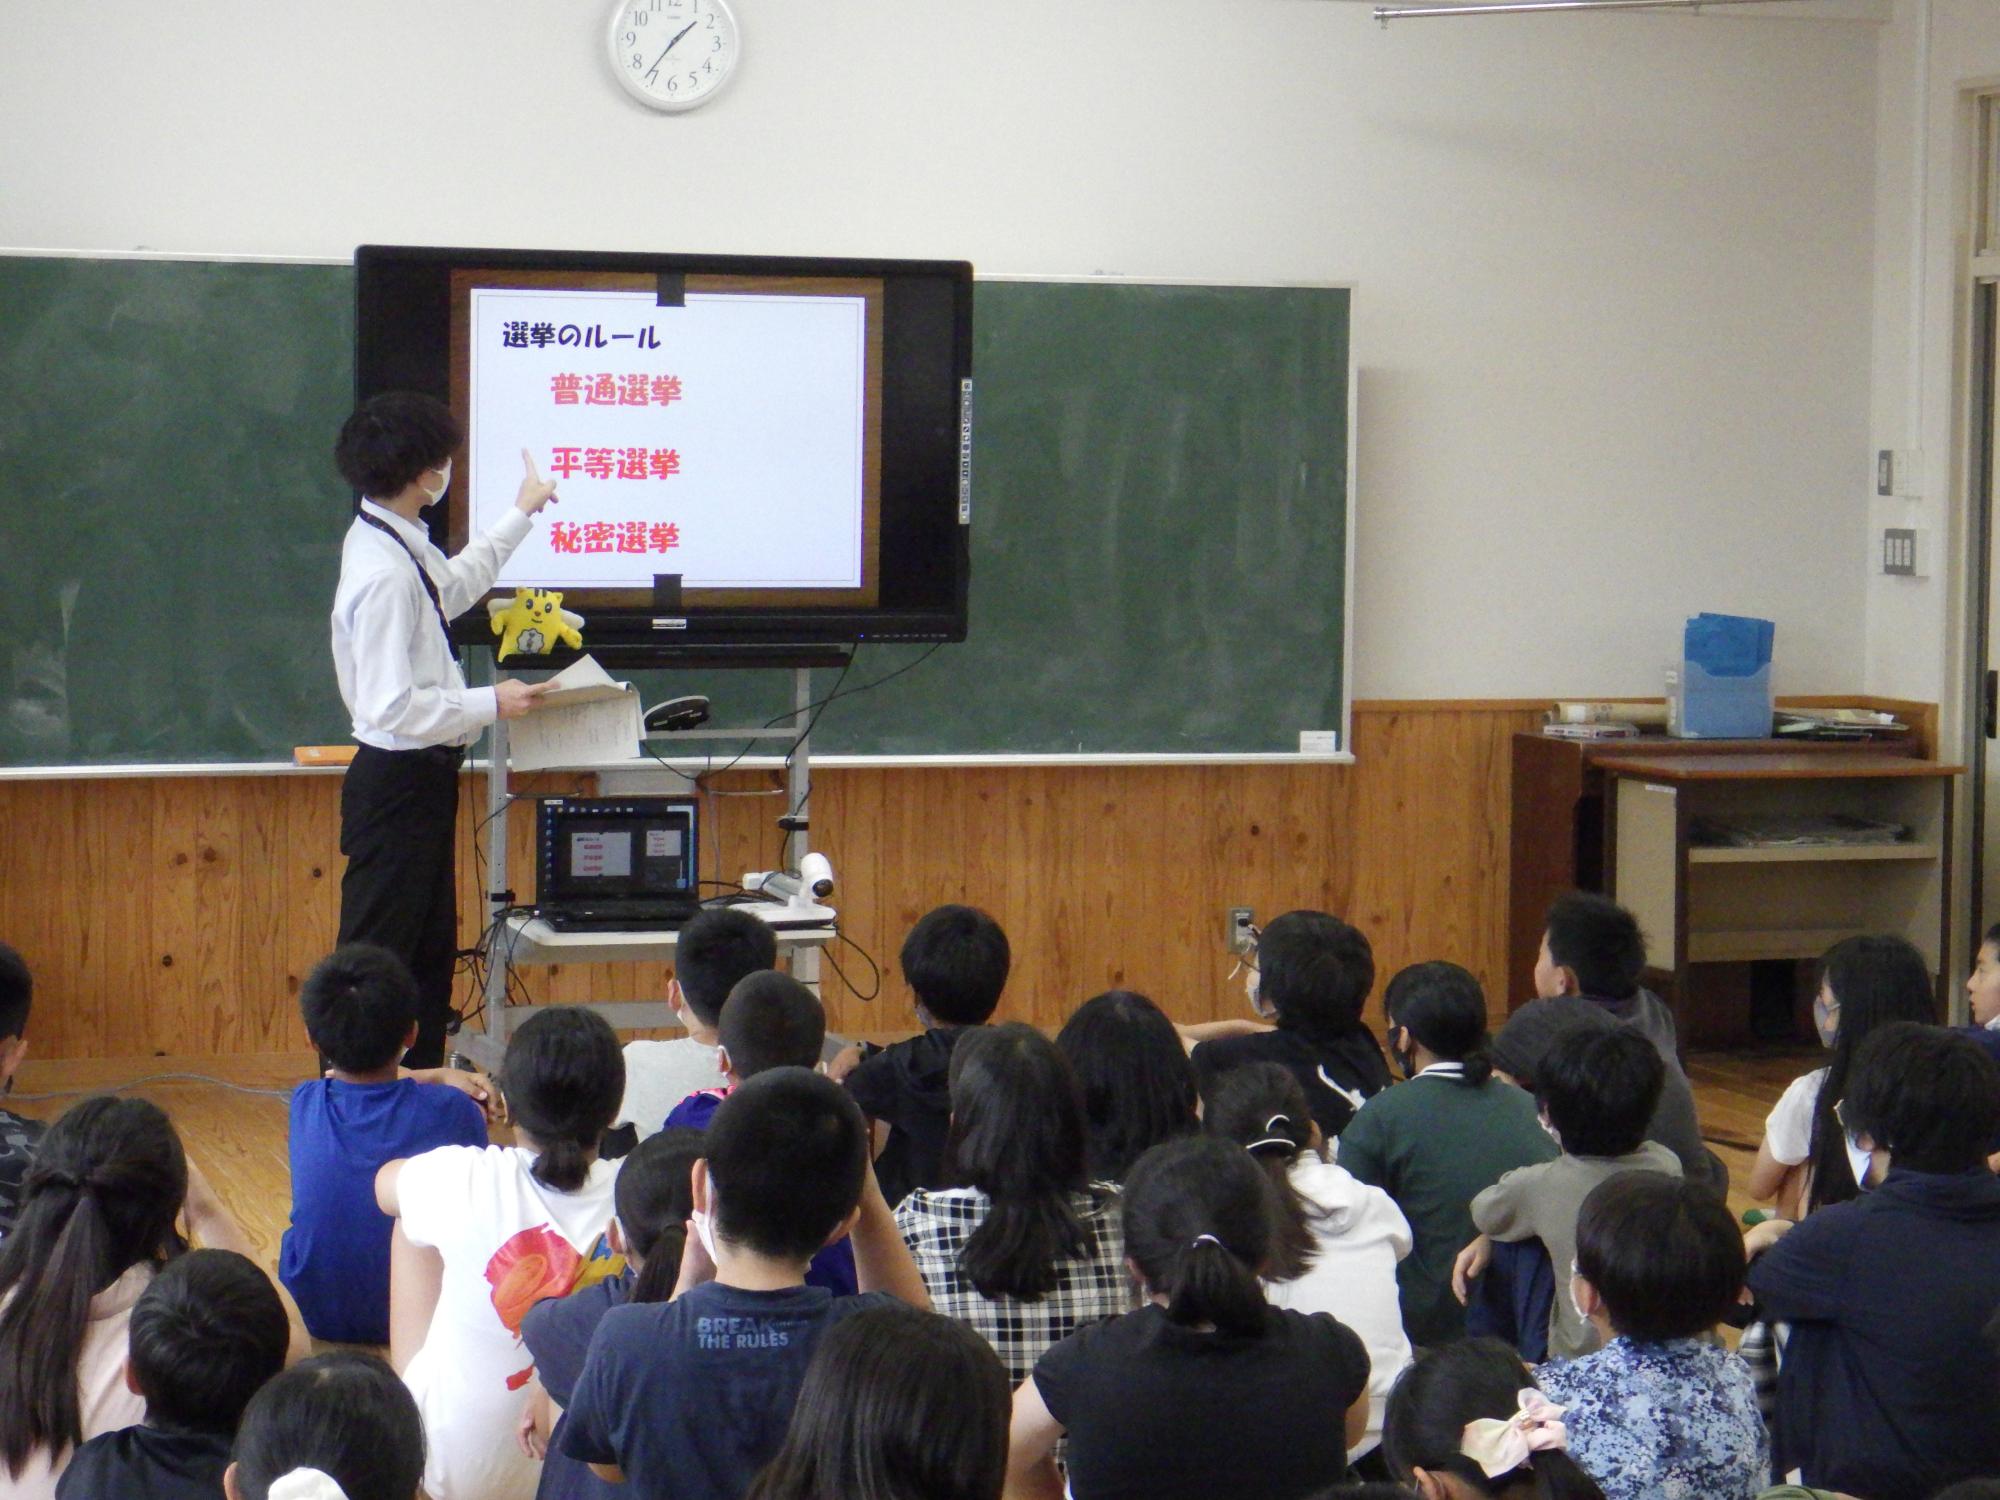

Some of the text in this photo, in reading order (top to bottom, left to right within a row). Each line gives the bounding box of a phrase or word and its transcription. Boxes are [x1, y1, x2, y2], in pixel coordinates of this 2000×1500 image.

[634, 10, 648, 26] 10
[706, 13, 715, 29] 2
[626, 31, 637, 48] 9
[712, 35, 722, 52] 3
[632, 53, 642, 69] 8
[702, 57, 712, 73] 4
[650, 69, 659, 86] 7
[667, 74, 678, 91] 6
[688, 71, 698, 88] 5
[502, 321, 661, 349] 選挙のルール
[550, 372, 682, 407] 普通選挙
[550, 447, 681, 480] 平等選挙
[550, 521, 680, 554] 秘密選挙
[697, 1317, 777, 1335] BREAK
[697, 1331, 789, 1349] THE RULES
